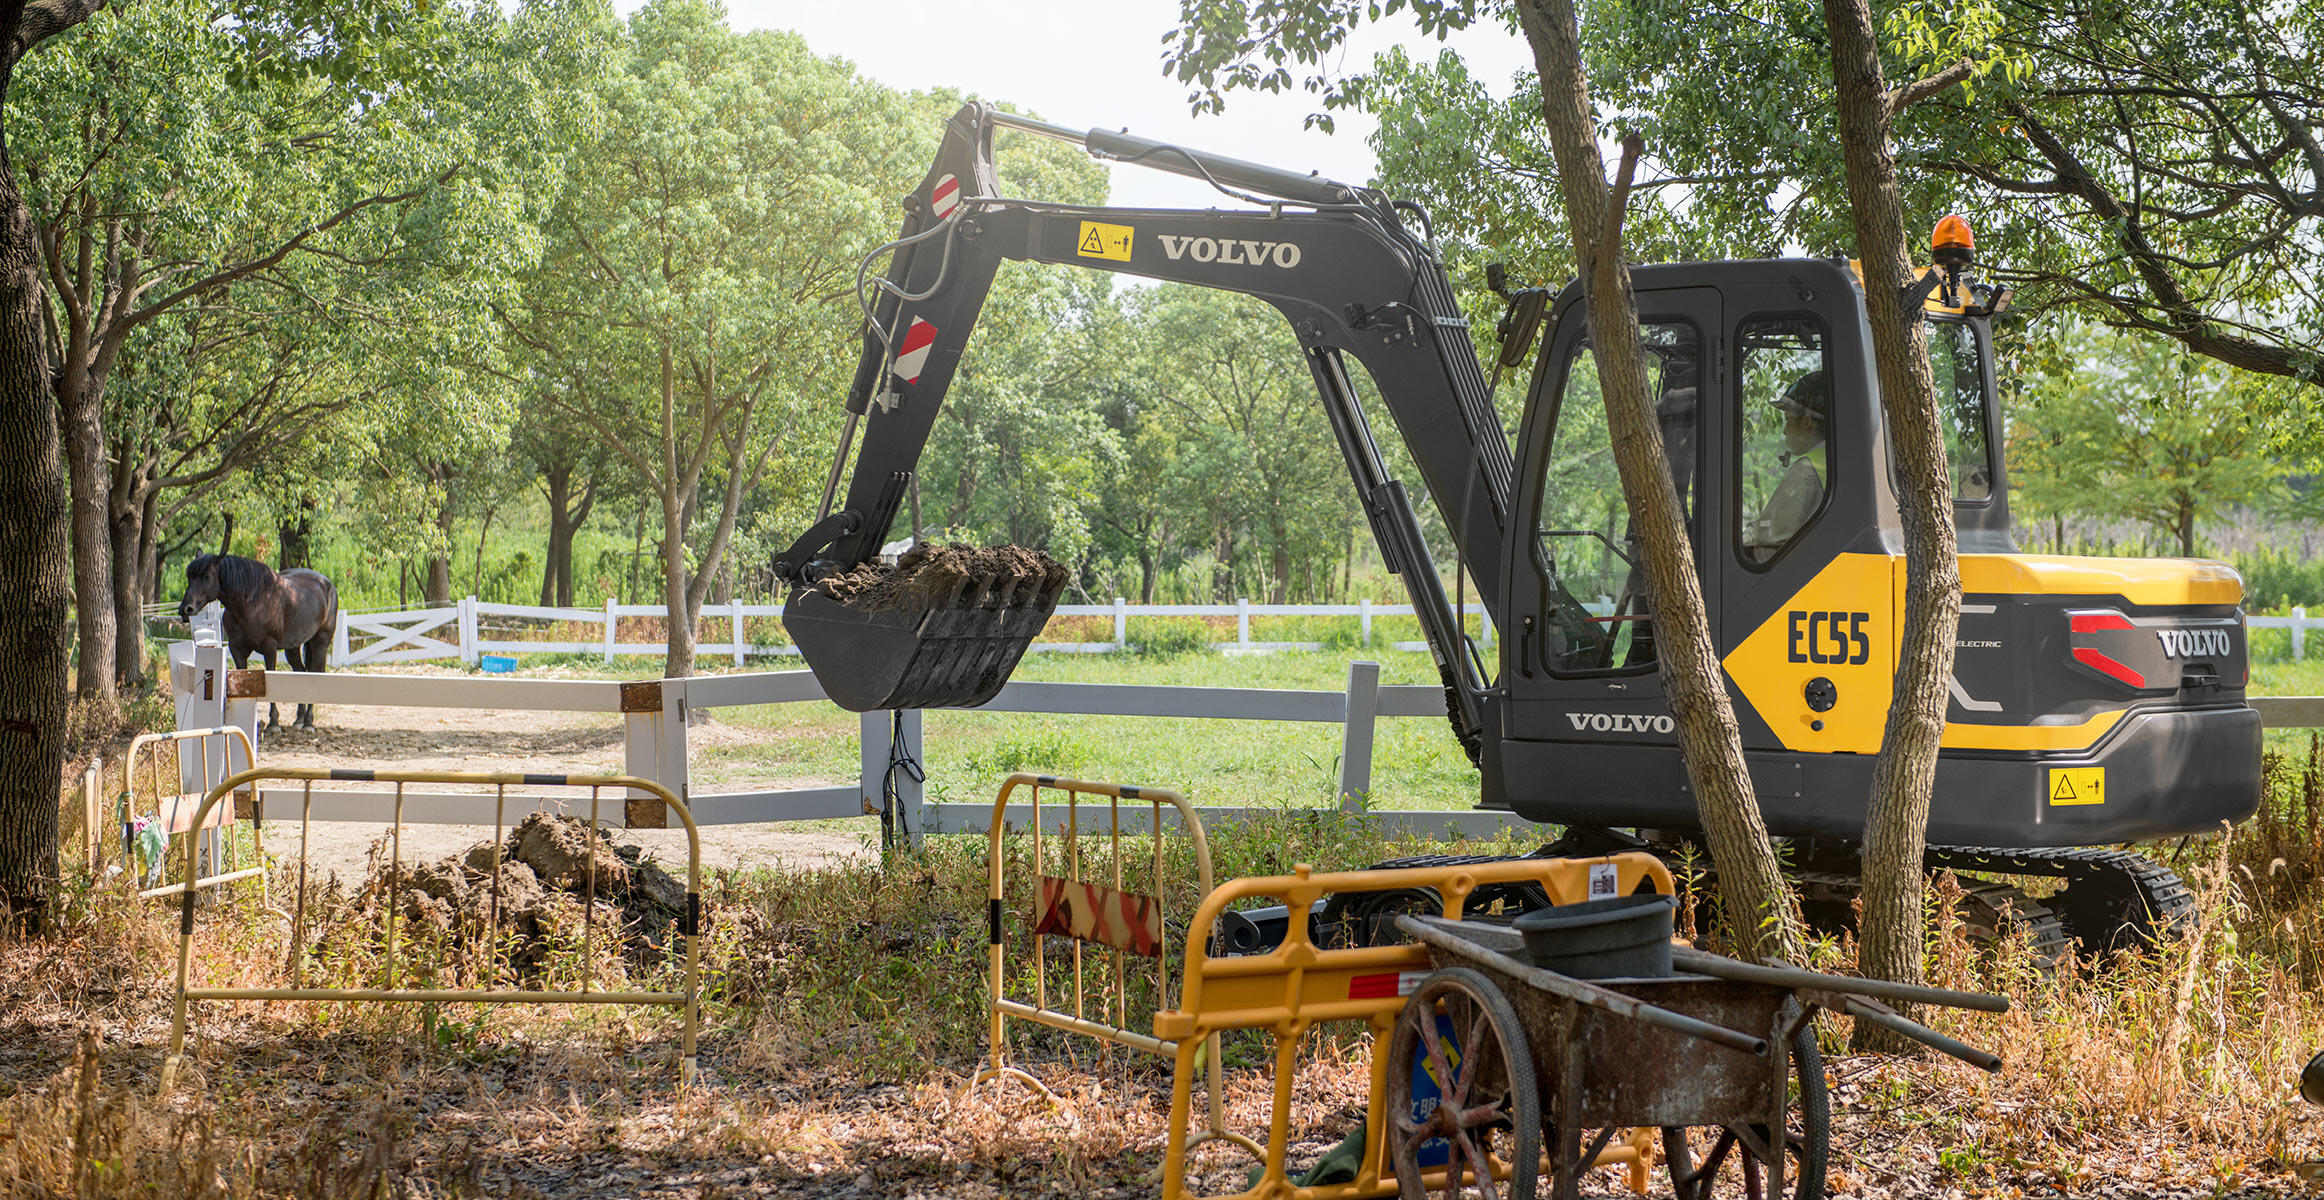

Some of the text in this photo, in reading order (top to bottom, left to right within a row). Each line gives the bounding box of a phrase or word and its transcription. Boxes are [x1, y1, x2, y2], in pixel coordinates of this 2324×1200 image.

[1158, 234, 1302, 269] VOLVO
[1787, 610, 1870, 666] EC55
[1956, 640, 2002, 648] ELECTRIC
[2156, 629, 2231, 660] VOLVO
[1566, 713, 1675, 734] VOLVO
